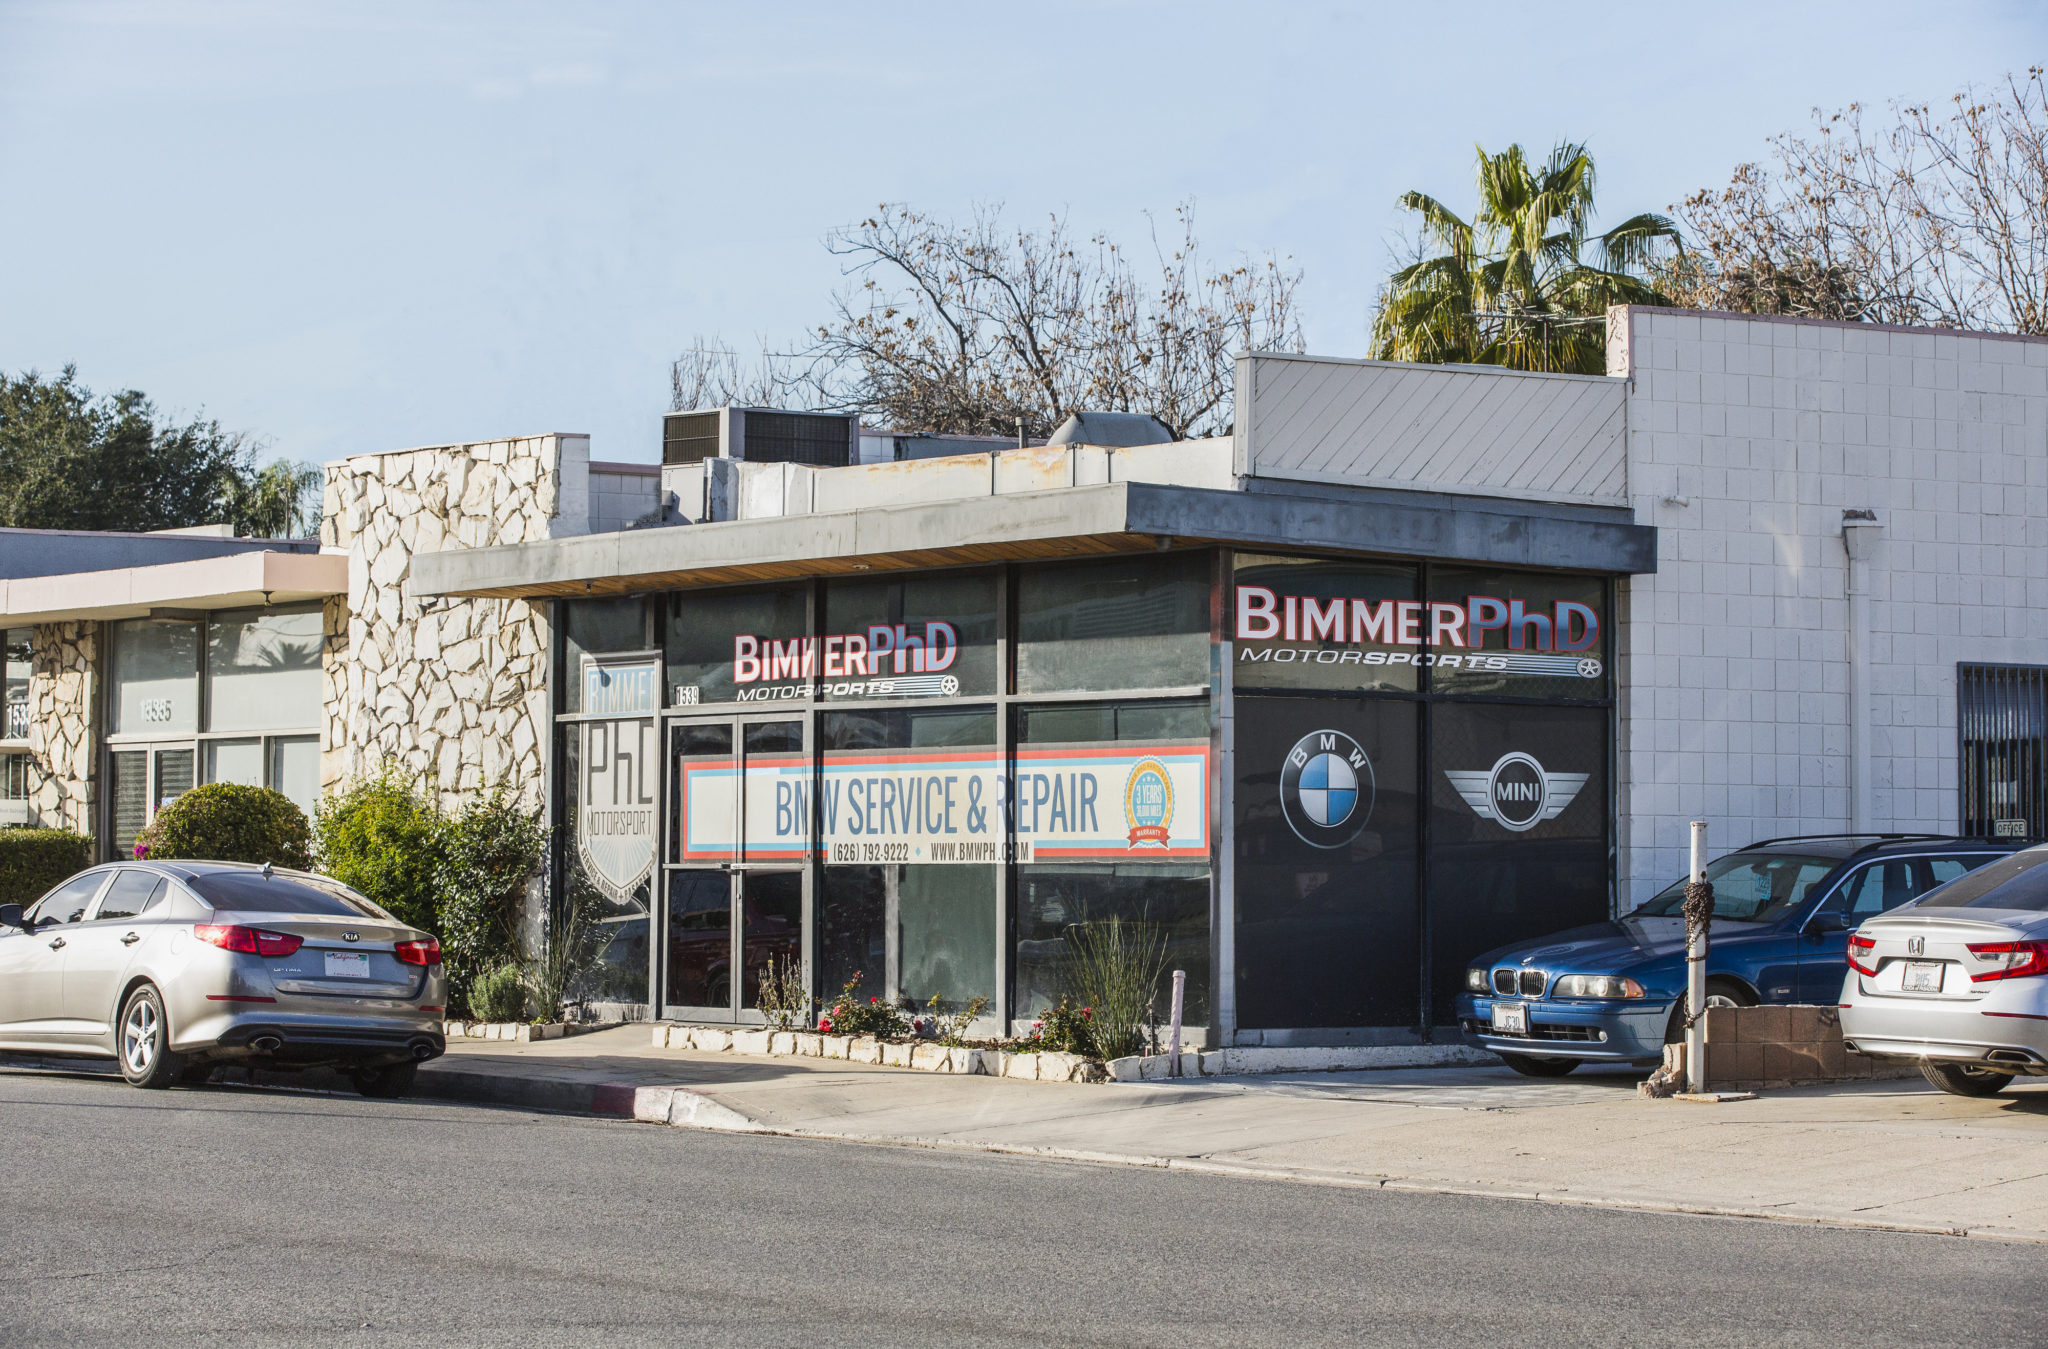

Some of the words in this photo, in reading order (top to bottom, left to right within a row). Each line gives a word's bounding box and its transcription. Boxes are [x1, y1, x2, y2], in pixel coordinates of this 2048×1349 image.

[1240, 647, 1509, 671] MOTORSPORTS
[677, 687, 699, 704] 1539
[1290, 734, 1367, 770] BMW
[1136, 784, 1141, 804] 3
[1143, 784, 1162, 804] YEARS
[1497, 782, 1540, 801] MINI
[848, 776, 958, 835] SERVICE
[967, 775, 987, 834] &
[997, 772, 1099, 834] REPAIR
[1136, 828, 1161, 837] WARRANTY
[833, 843, 860, 862] (626)
[863, 842, 909, 861] 792-9222
[581, 848, 598, 880] SERVICE
